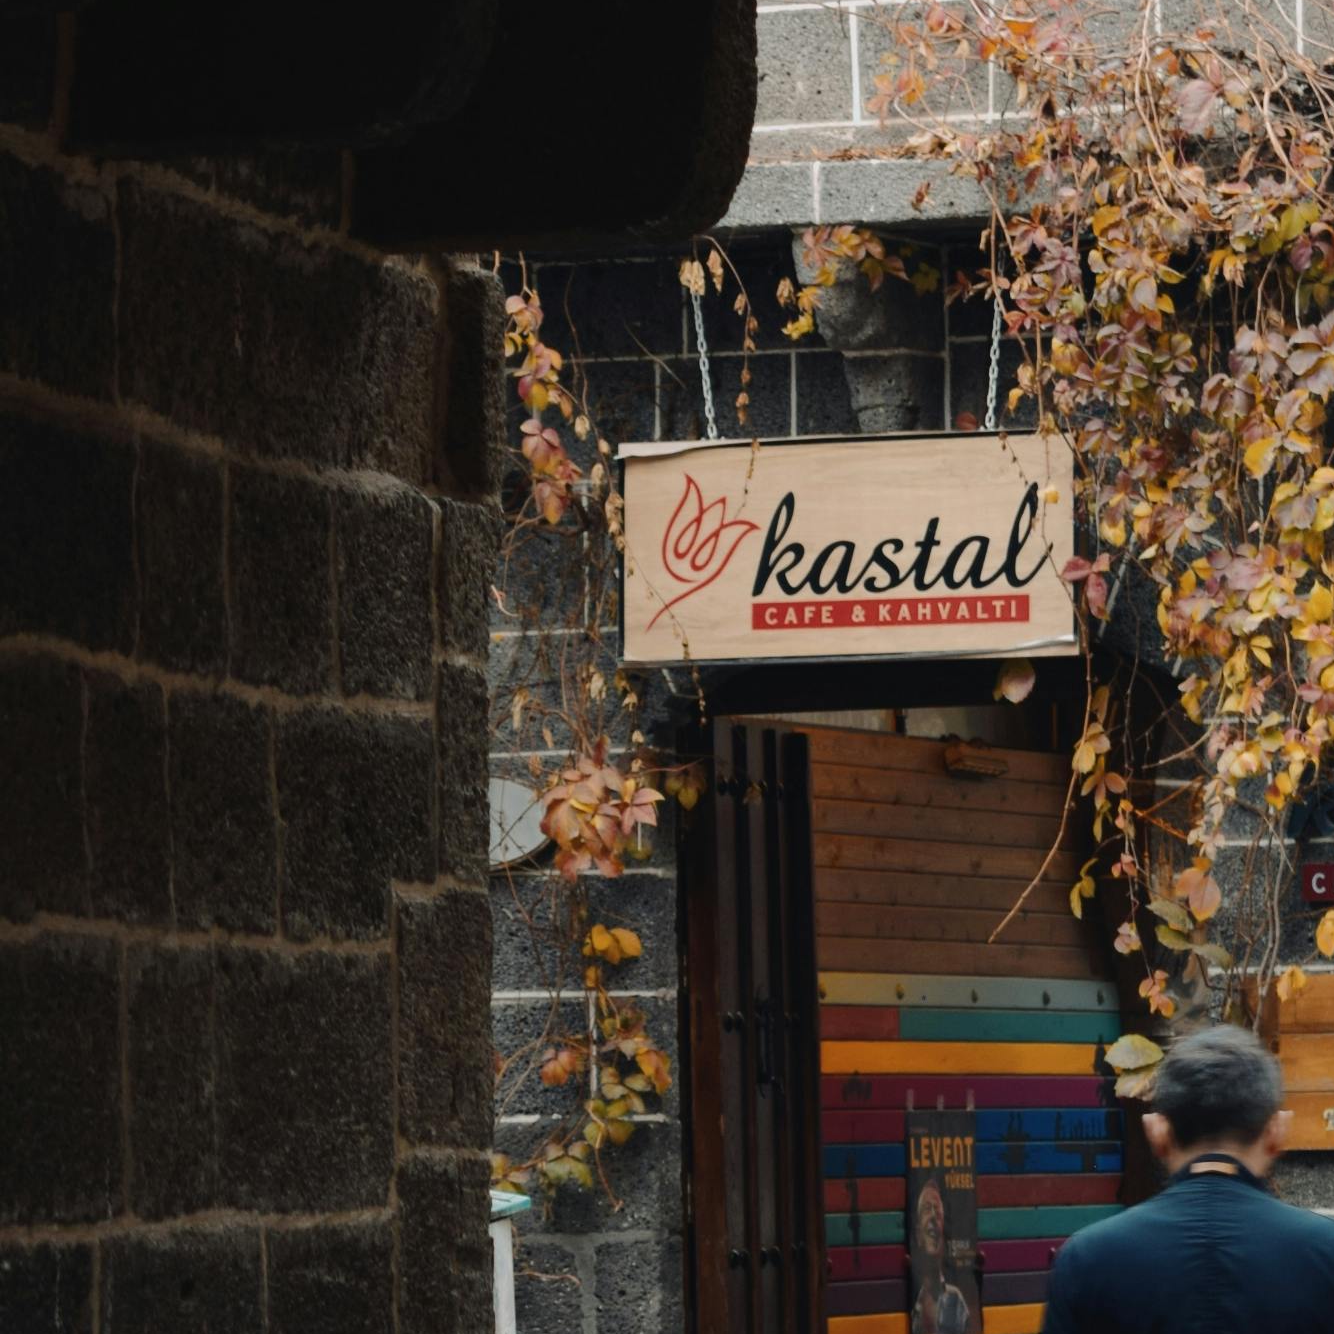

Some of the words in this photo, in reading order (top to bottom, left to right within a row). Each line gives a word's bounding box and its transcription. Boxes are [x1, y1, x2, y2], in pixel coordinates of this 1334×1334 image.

[751, 481, 1054, 597] kastal
[765, 605, 834, 626] CAFE
[851, 604, 866, 623] &
[878, 599, 1018, 622] KAHVALTI
[910, 1136, 974, 1168] LEVENT
